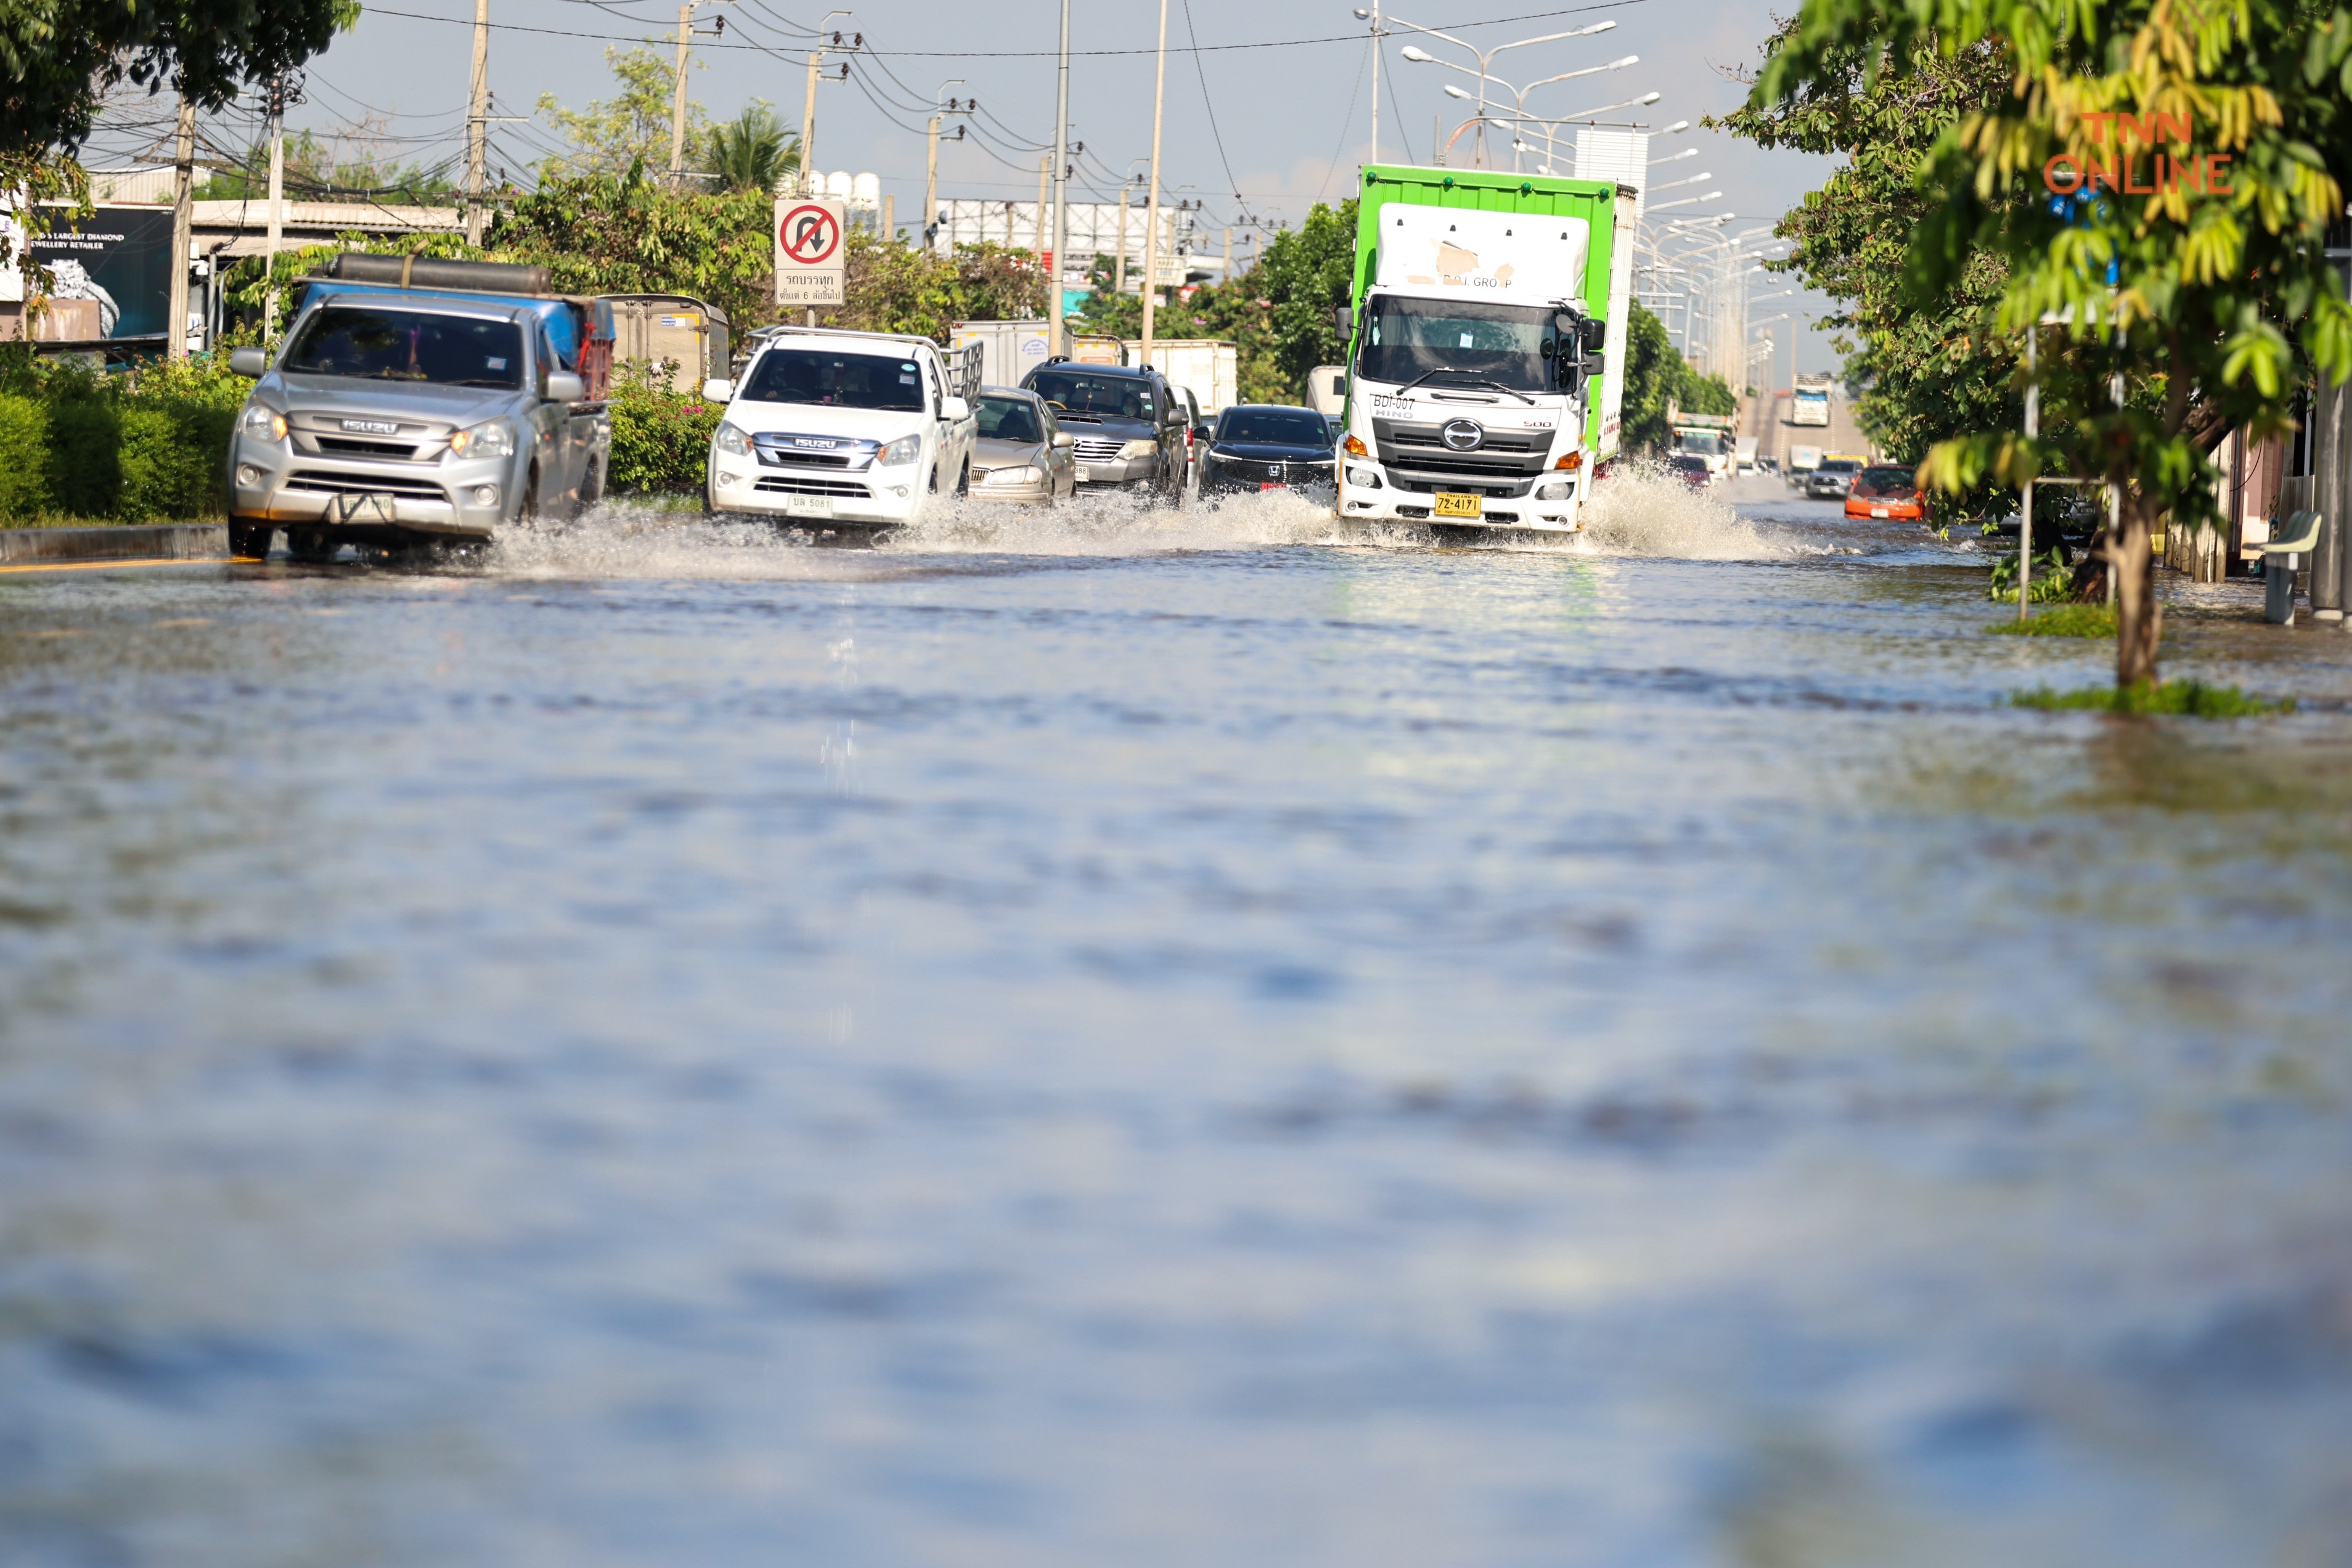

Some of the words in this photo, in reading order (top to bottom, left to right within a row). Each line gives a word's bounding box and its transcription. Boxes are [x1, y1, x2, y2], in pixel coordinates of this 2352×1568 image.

[87, 234, 125, 242] DIAMOND
[30, 240, 68, 248] EWELLERY
[786, 276, 833, 288] รถบรรทุก
[1474, 277, 1512, 288] GROP
[780, 288, 799, 300] ตั้งแต่
[803, 292, 808, 300] 6
[1374, 395, 1415, 410] BDI-007
[1376, 409, 1413, 419] HINO
[343, 420, 396, 433] ISUZU
[796, 438, 836, 449] ISUZU
[810, 498, 830, 508] 5081
[1438, 497, 1476, 510] 72-4171
